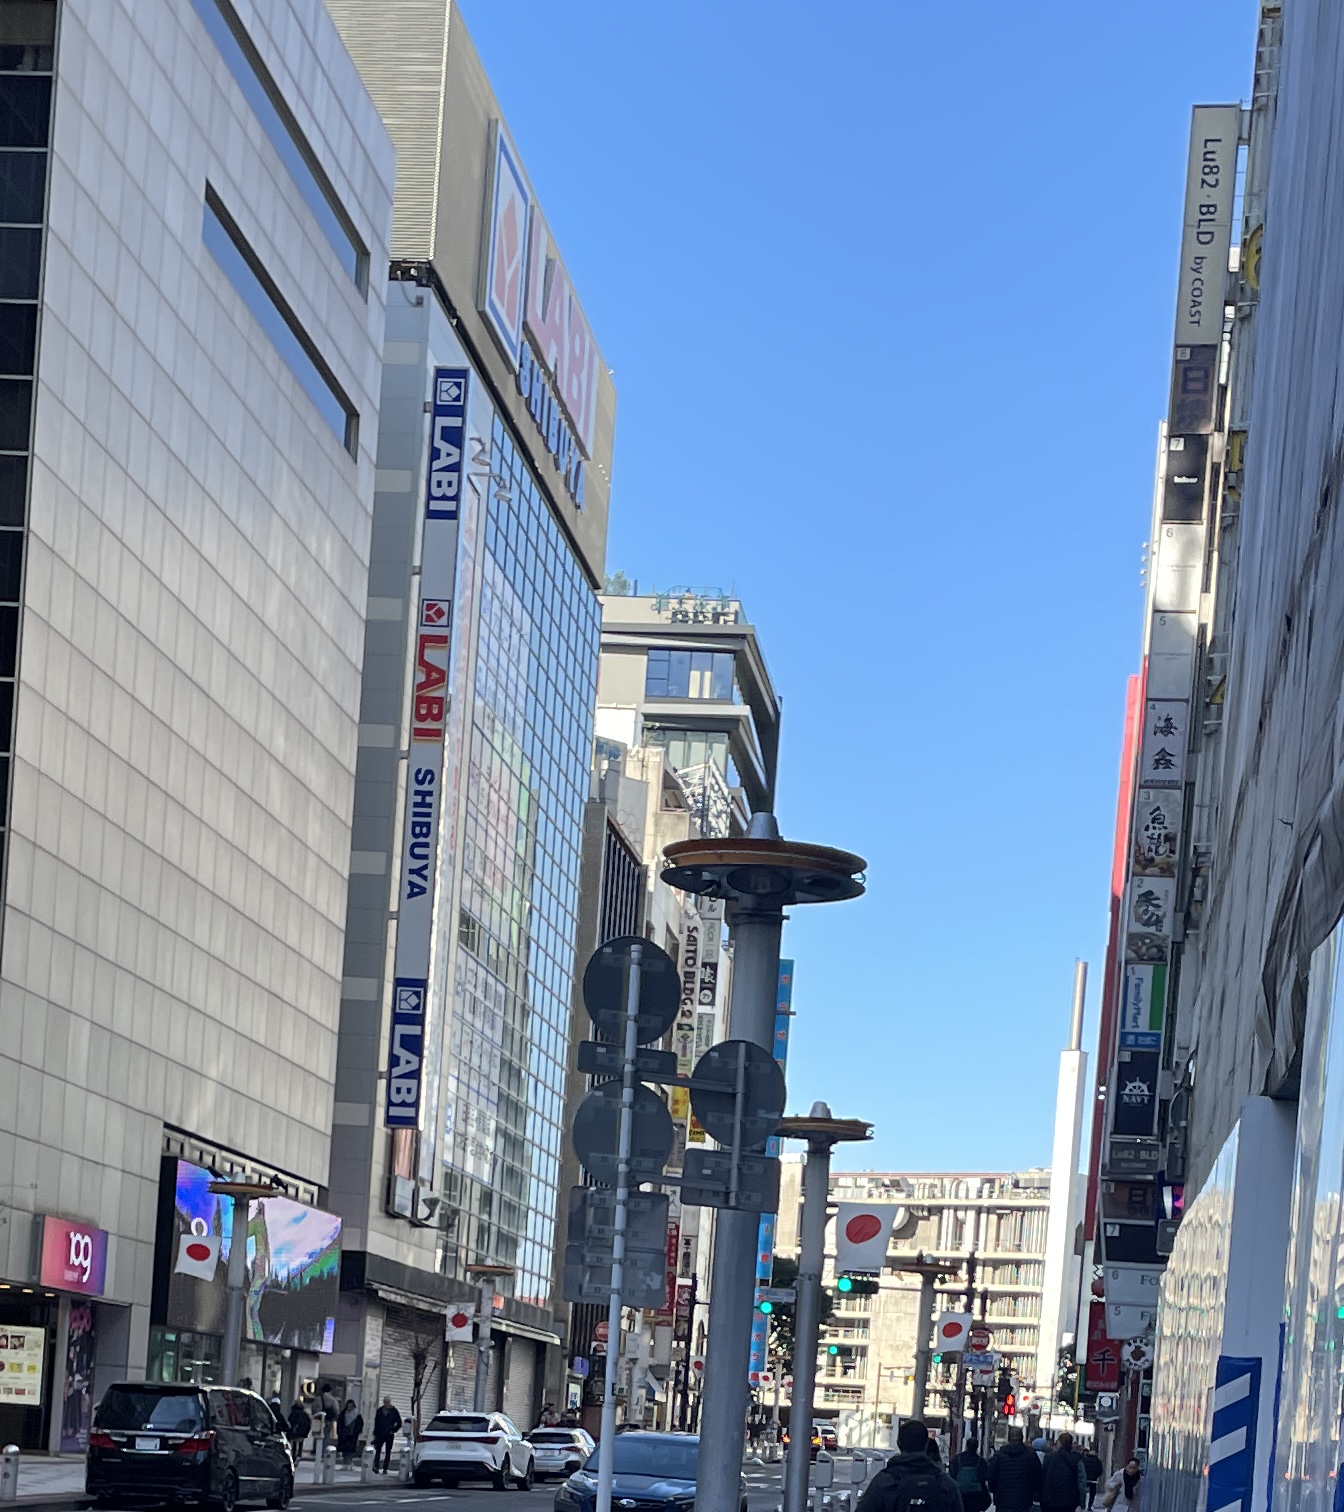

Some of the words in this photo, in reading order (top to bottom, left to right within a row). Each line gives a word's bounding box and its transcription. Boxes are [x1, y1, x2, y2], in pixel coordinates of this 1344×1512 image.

[1196, 203, 1218, 246] BLD
[1188, 277, 1205, 328] COAST
[524, 206, 599, 461] LABI
[429, 416, 462, 511] LABI
[413, 634, 449, 742] LABI
[406, 767, 435, 900] SHIBUYA
[1131, 977, 1144, 1029] FamilyMart
[388, 1024, 422, 1117] LABI
[1122, 1095, 1149, 1104] NAVY
[1111, 1271, 1119, 1280] 6
[1114, 1306, 1121, 1317] 5
